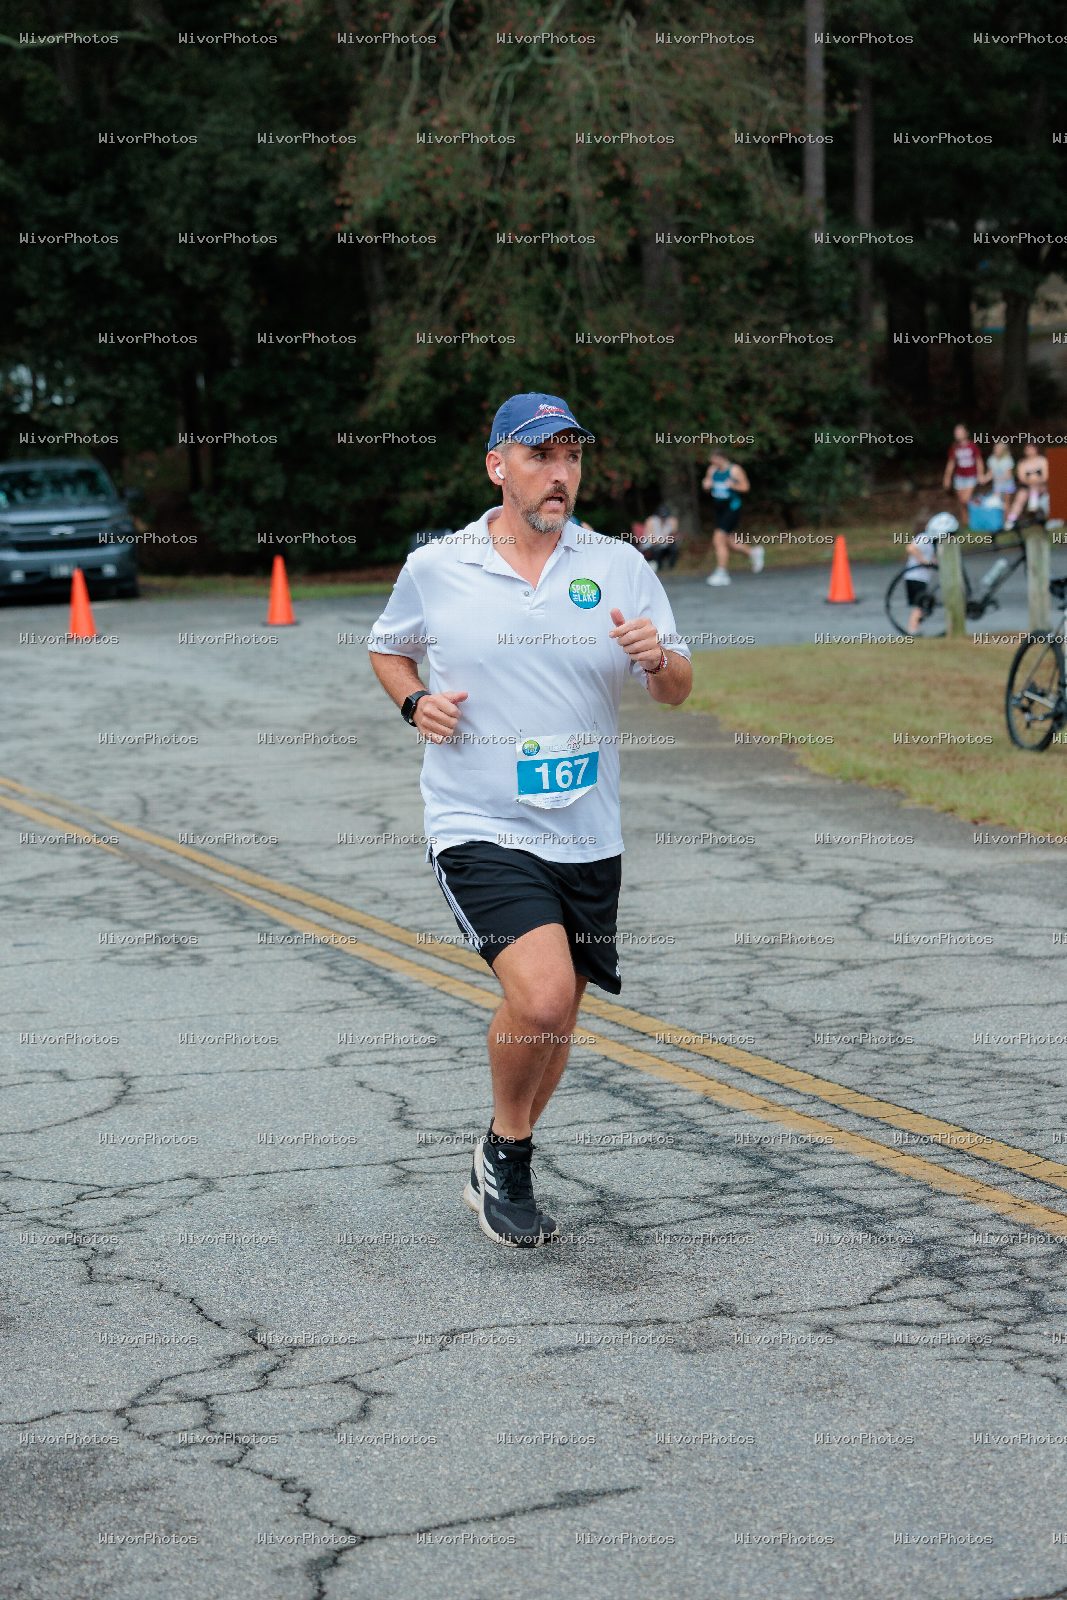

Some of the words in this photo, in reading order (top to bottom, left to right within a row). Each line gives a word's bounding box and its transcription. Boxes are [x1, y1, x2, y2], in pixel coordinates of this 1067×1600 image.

[571, 584, 591, 593] SPOT
[578, 592, 597, 602] LAKE
[535, 757, 590, 790] 167
